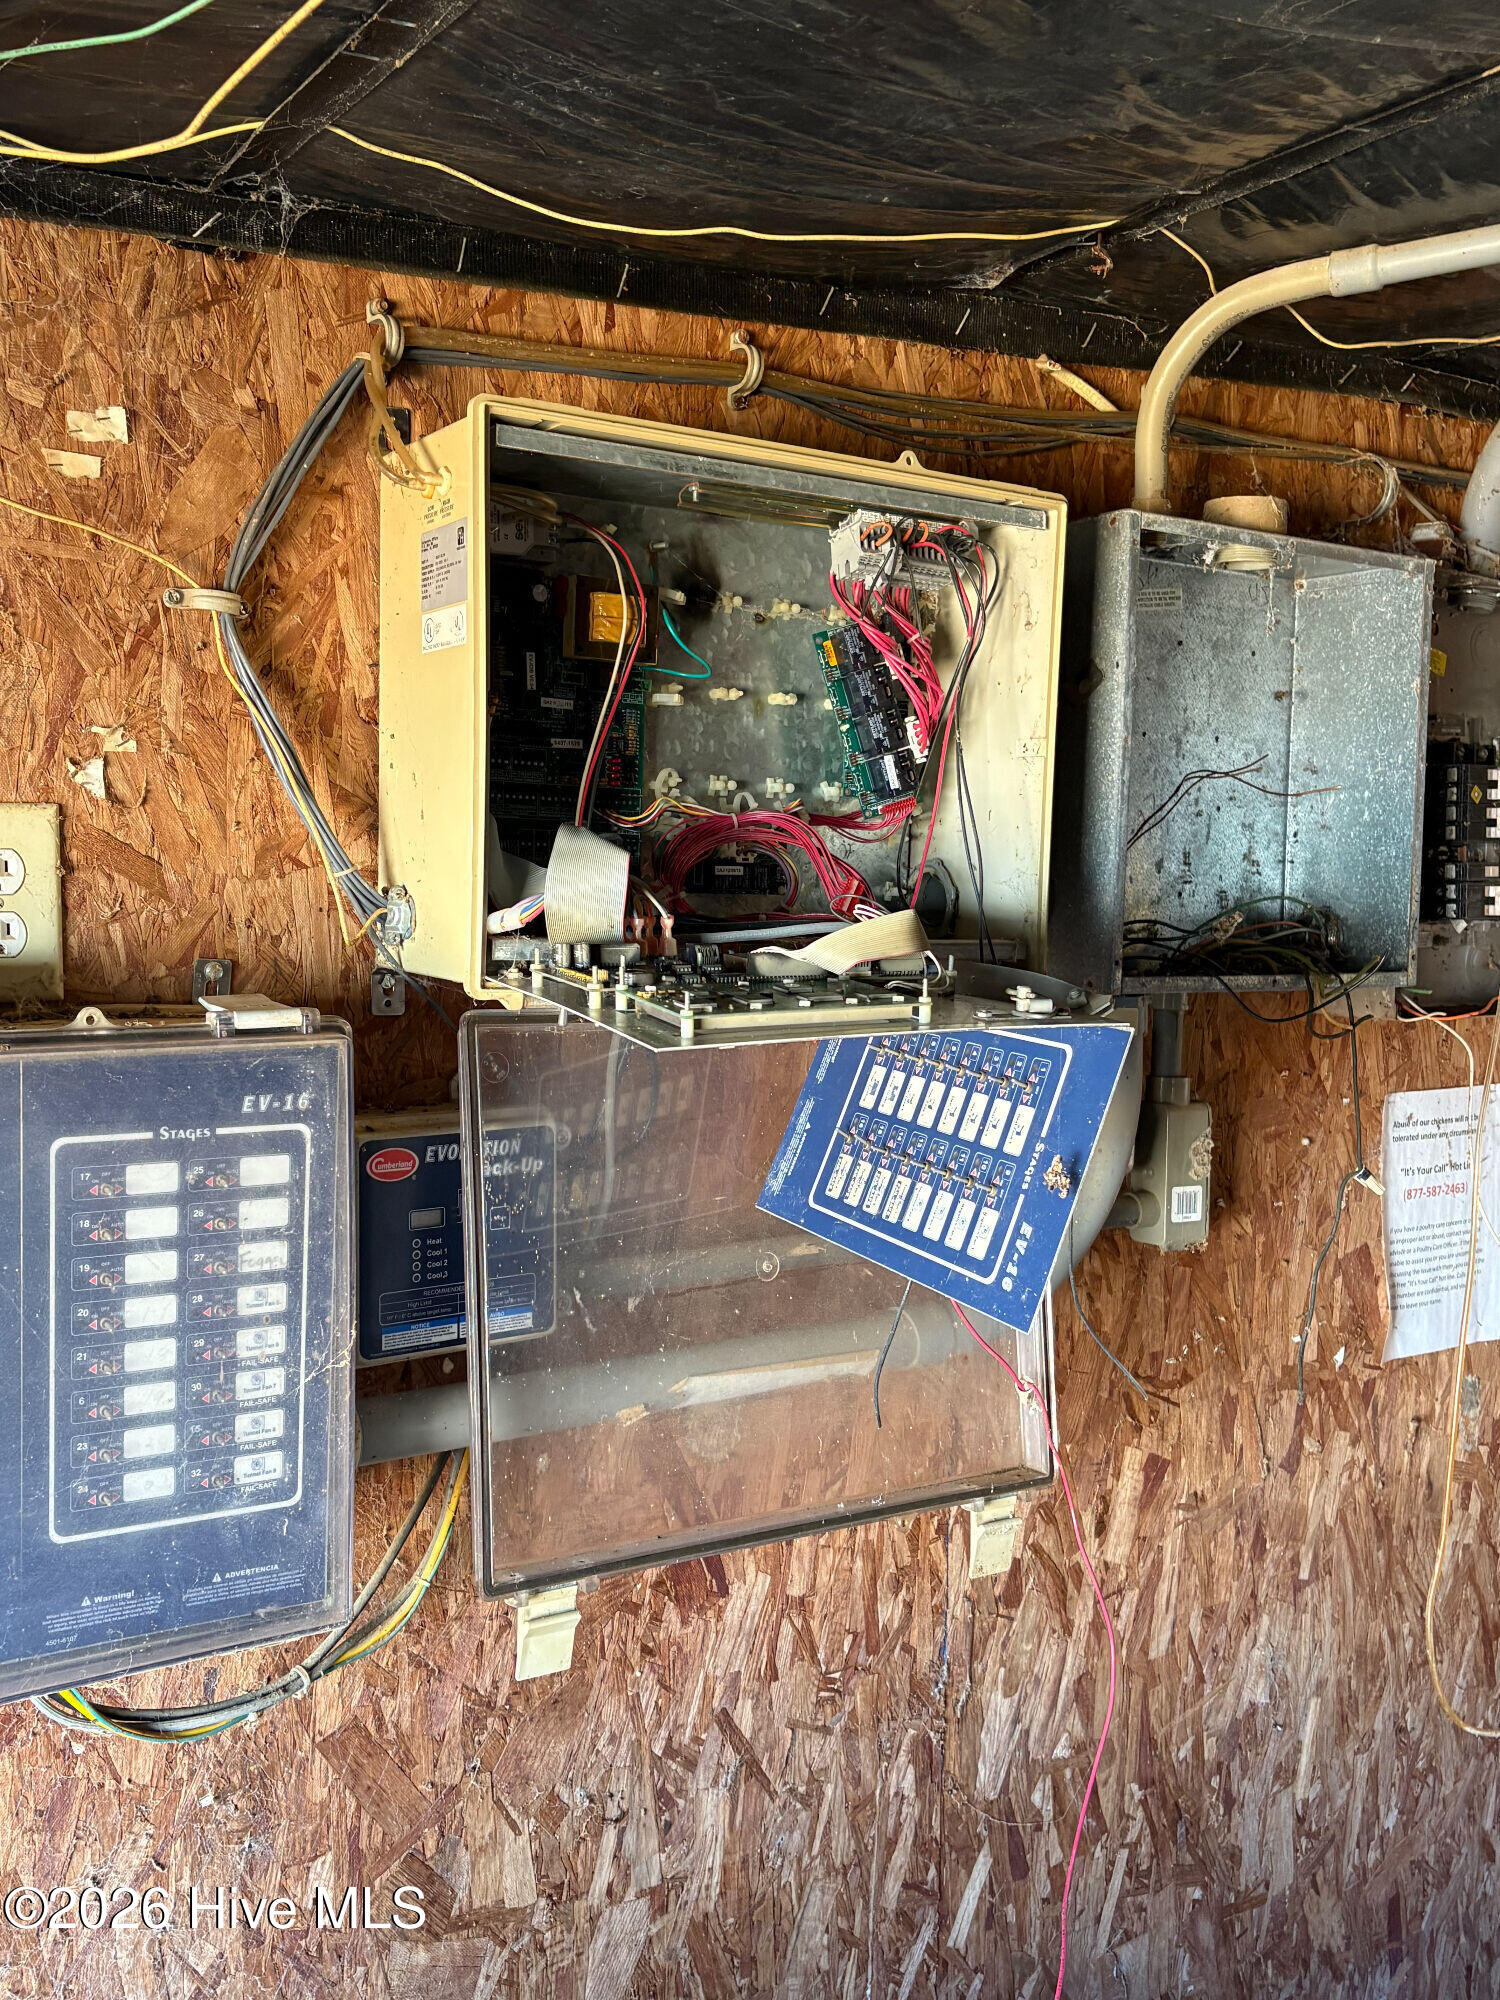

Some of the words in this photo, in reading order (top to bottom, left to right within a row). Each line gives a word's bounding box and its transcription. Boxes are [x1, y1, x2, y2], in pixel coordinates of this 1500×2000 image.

[241, 1093, 310, 1113] EV-16
[1393, 1120, 1410, 1129] Abuse
[1412, 1118, 1419, 1126] of
[1431, 1115, 1453, 1125] chickens
[1392, 1133, 1419, 1142] tolerated
[372, 1157, 413, 1172] Cumberland
[1417, 1165, 1432, 1174] Your
[1450, 1163, 1462, 1171] Hot
[194, 1166, 204, 1174] 25
[1404, 1182, 1468, 1202] (877-587-2463)
[79, 1220, 90, 1228] 18
[427, 1237, 442, 1245] Heat
[194, 1254, 204, 1262] 27
[79, 1264, 90, 1272] 19
[192, 1295, 203, 1303] 28
[77, 1309, 88, 1317] 20
[194, 1339, 204, 1347] 29
[77, 1353, 87, 1361] 21
[191, 1383, 202, 1391] 30
[79, 1397, 85, 1405] 6
[191, 1469, 201, 1477] 32
[225, 1564, 278, 1578] ADVERTENCIA
[94, 1590, 135, 1604] Warning!
